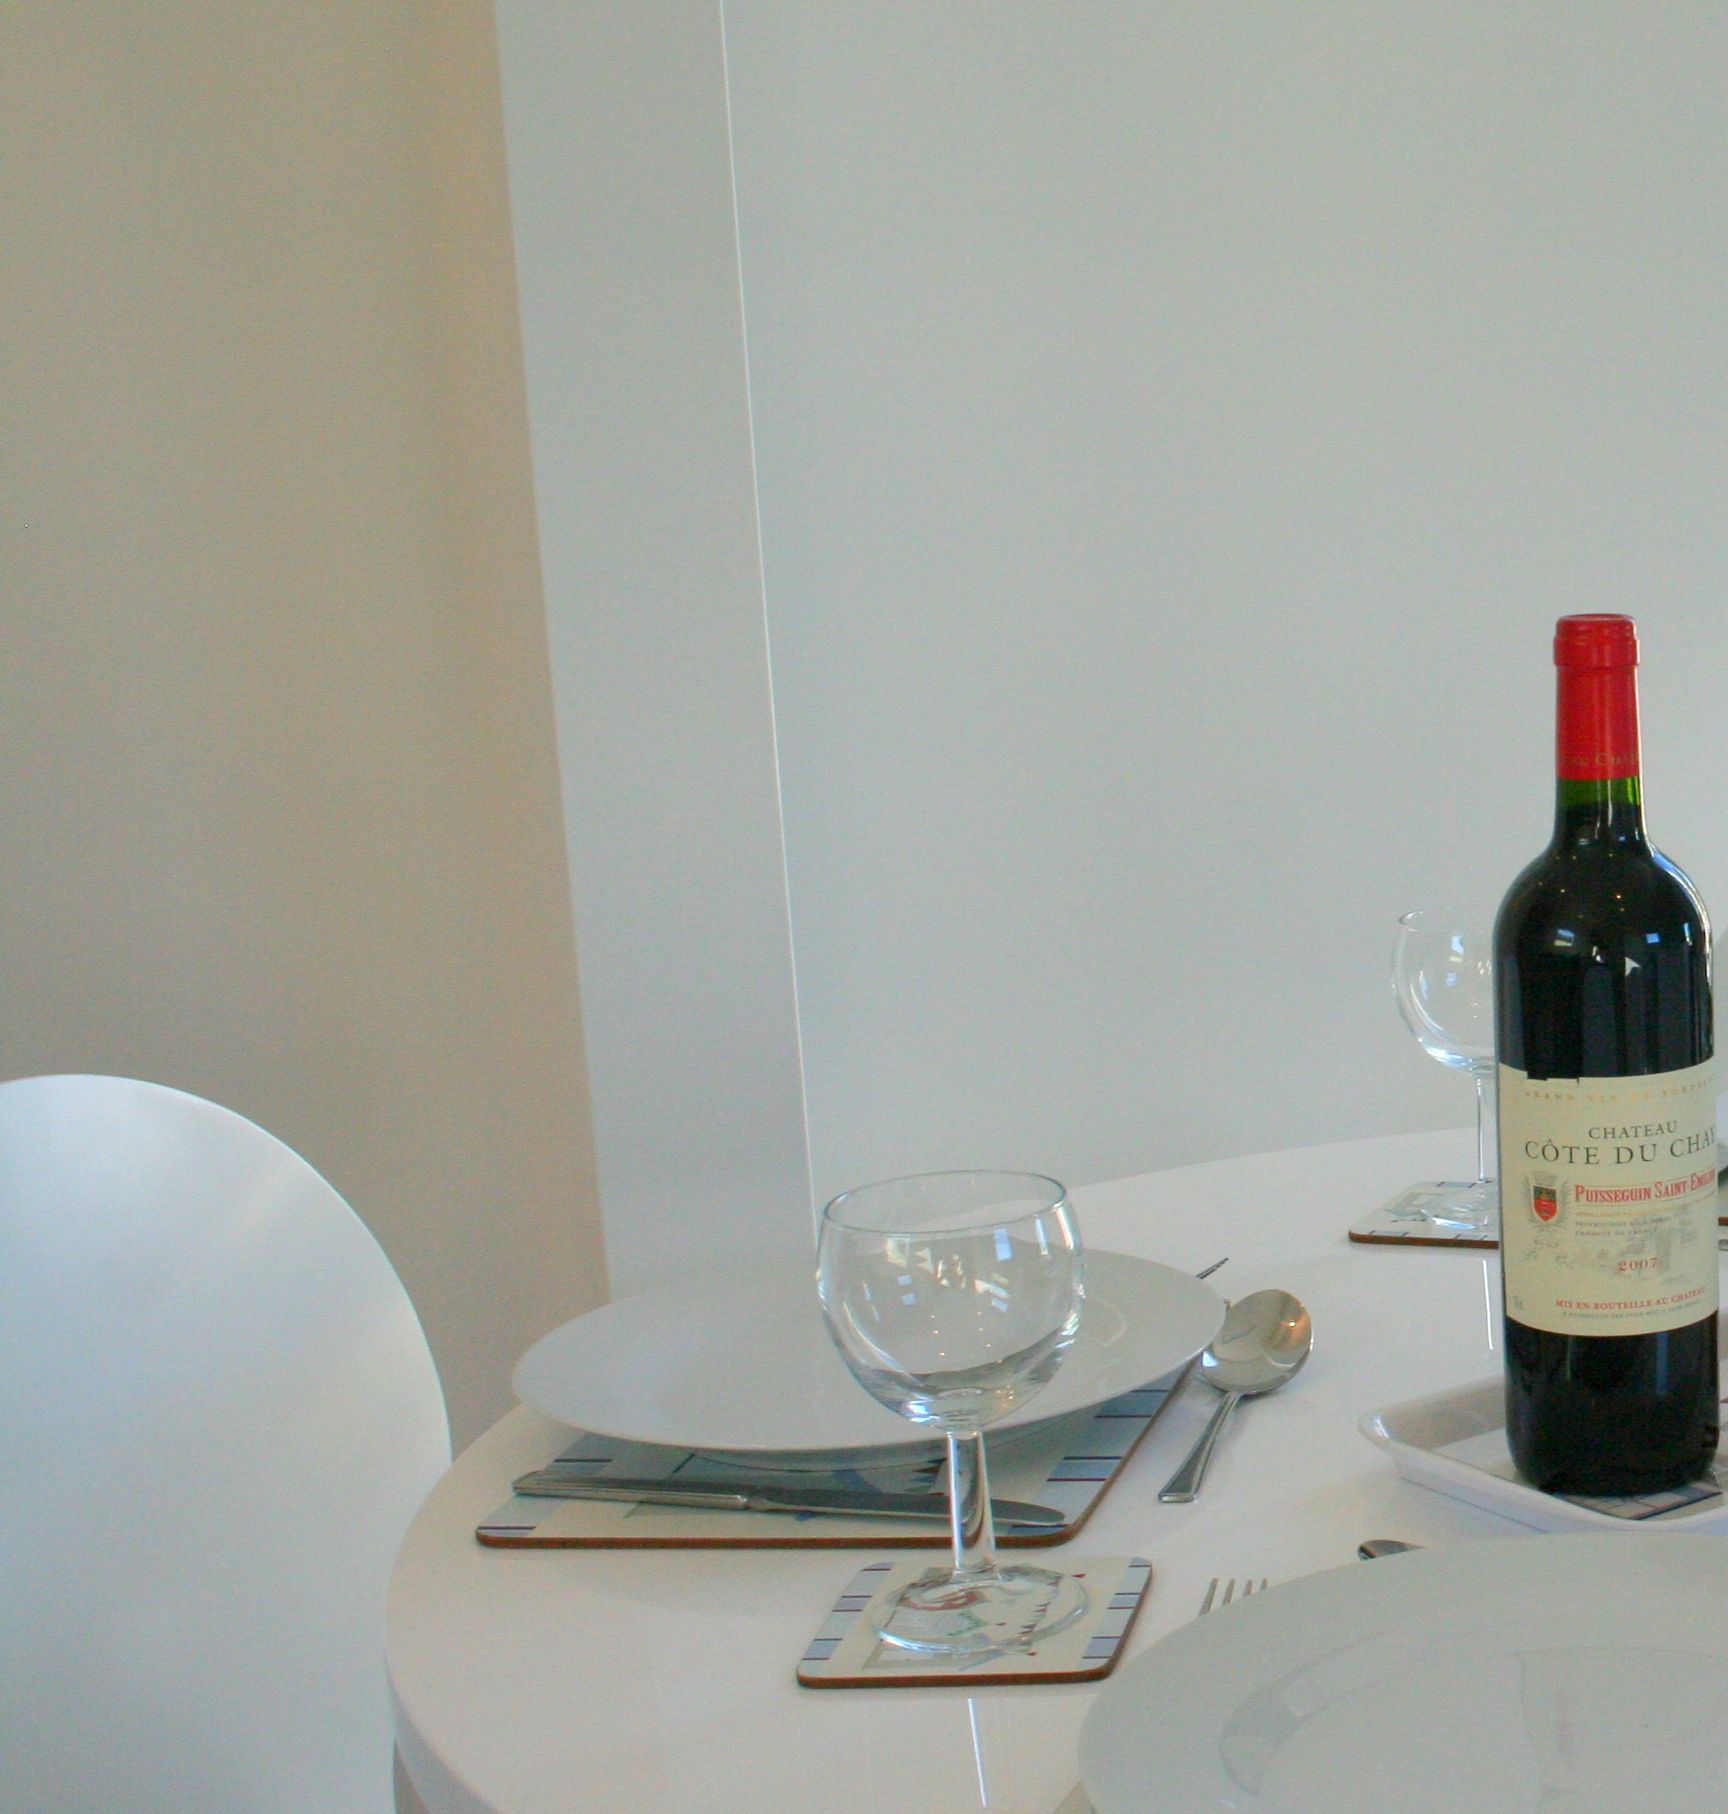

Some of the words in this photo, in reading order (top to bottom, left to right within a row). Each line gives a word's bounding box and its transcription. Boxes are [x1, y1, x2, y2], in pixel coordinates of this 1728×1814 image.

[1589, 1120, 1677, 1140] CHATEAU
[1525, 1139, 1600, 1165] CÔTE
[1615, 1143, 1657, 1165] DU
[1574, 1184, 1651, 1203] PUISSEGUIN
[1619, 1256, 1659, 1272] 2007
[1556, 1299, 1574, 1309] MIS
[1576, 1301, 1591, 1310] EN
[1594, 1299, 1651, 1311] BOUTEILLE
[1655, 1297, 1669, 1306] AU
